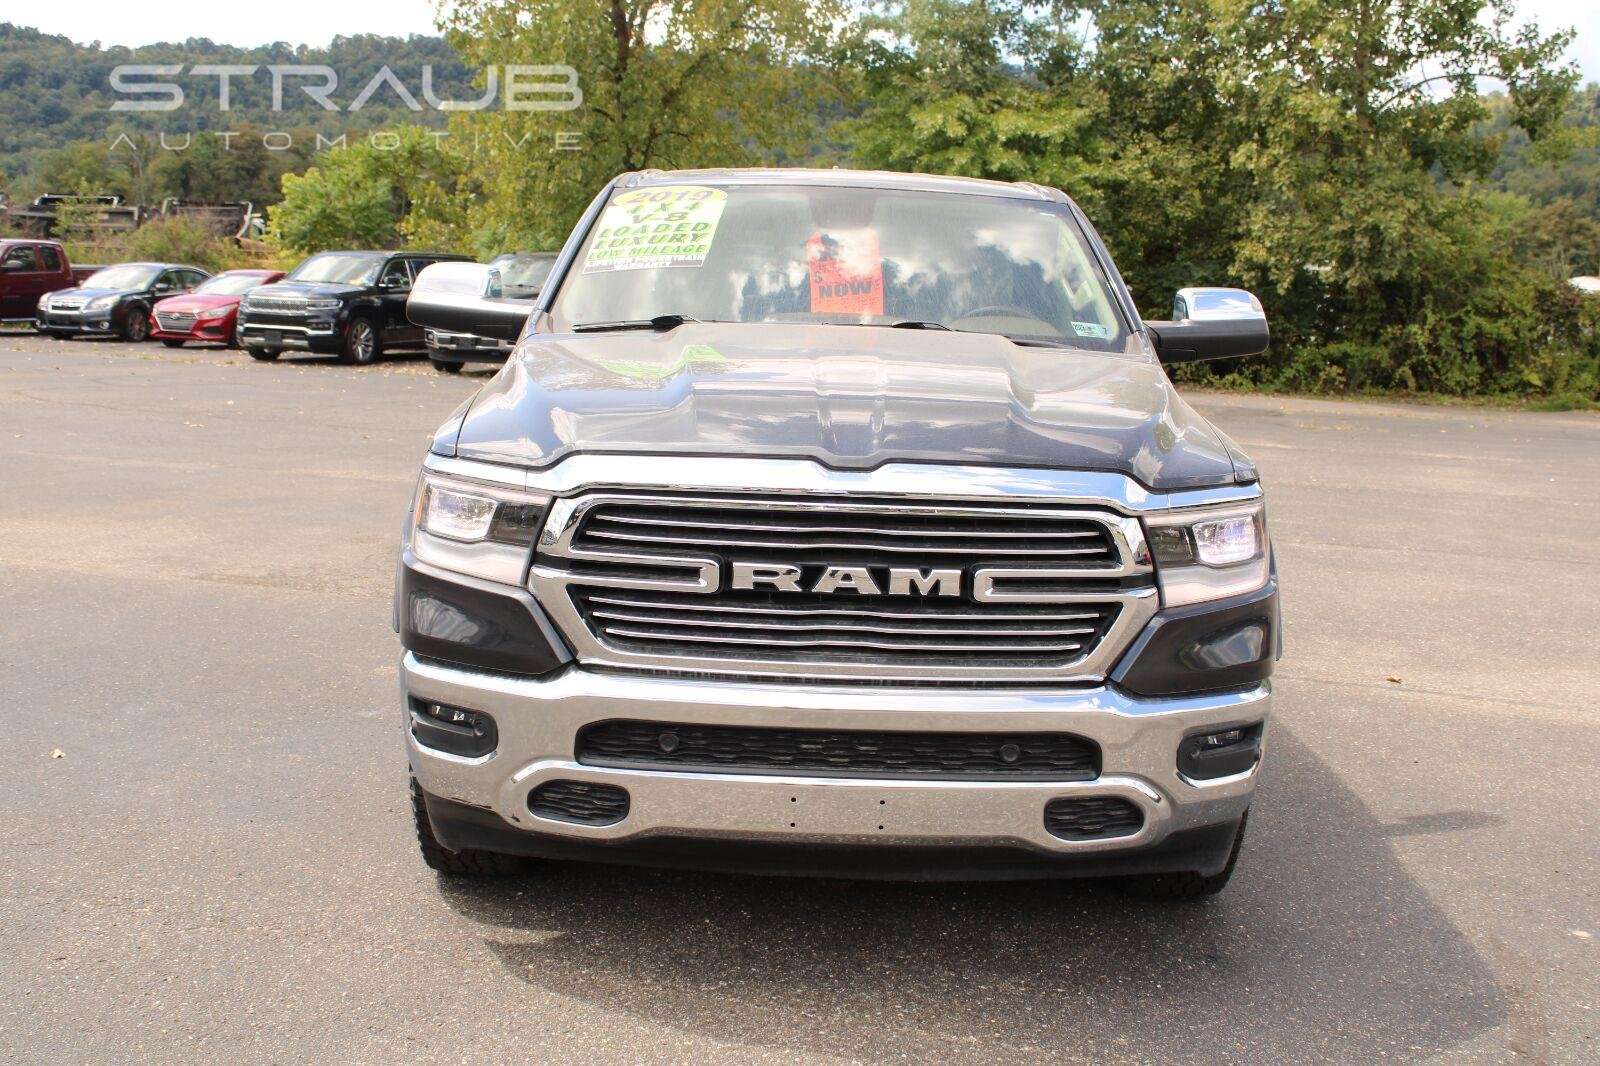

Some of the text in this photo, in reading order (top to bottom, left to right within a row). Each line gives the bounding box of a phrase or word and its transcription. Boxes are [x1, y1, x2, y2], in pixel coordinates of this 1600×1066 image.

[627, 190, 714, 204] 2019
[632, 211, 690, 224] V-8
[597, 222, 711, 238] LOADED
[593, 232, 710, 250] LUXURY
[588, 244, 708, 261] LOW MILEAGE
[818, 281, 872, 298] NOW
[732, 562, 962, 596] RAM
